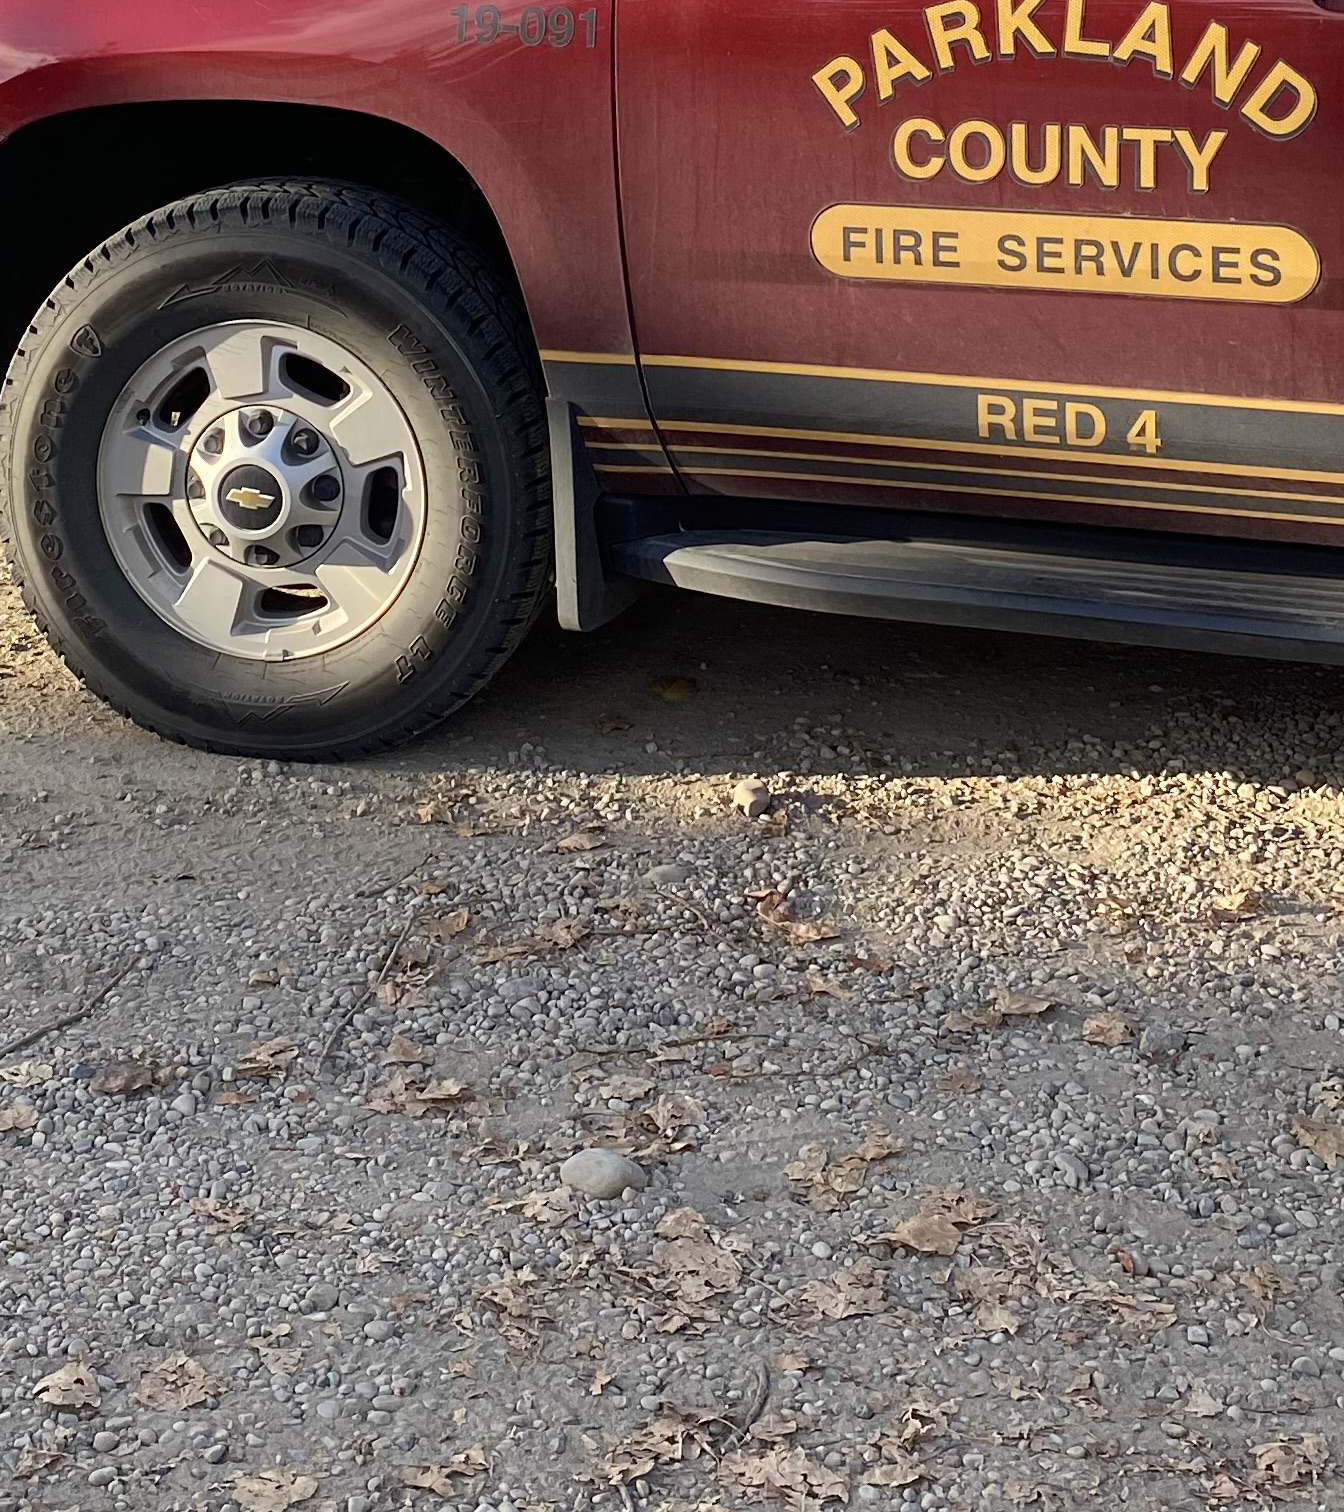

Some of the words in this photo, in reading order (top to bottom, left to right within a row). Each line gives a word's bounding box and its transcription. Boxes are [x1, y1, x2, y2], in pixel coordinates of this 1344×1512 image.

[450, 3, 597, 49] 19-091
[892, 116, 1228, 193] COUNTY
[841, 225, 960, 269] FIRE
[996, 233, 1283, 287] SERVICES
[976, 393, 1107, 448] RED
[1126, 408, 1162, 454] 4
[29, 367, 109, 638] Firestone
[387, 322, 484, 630] WINTERFORCE
[394, 635, 432, 685] LT
